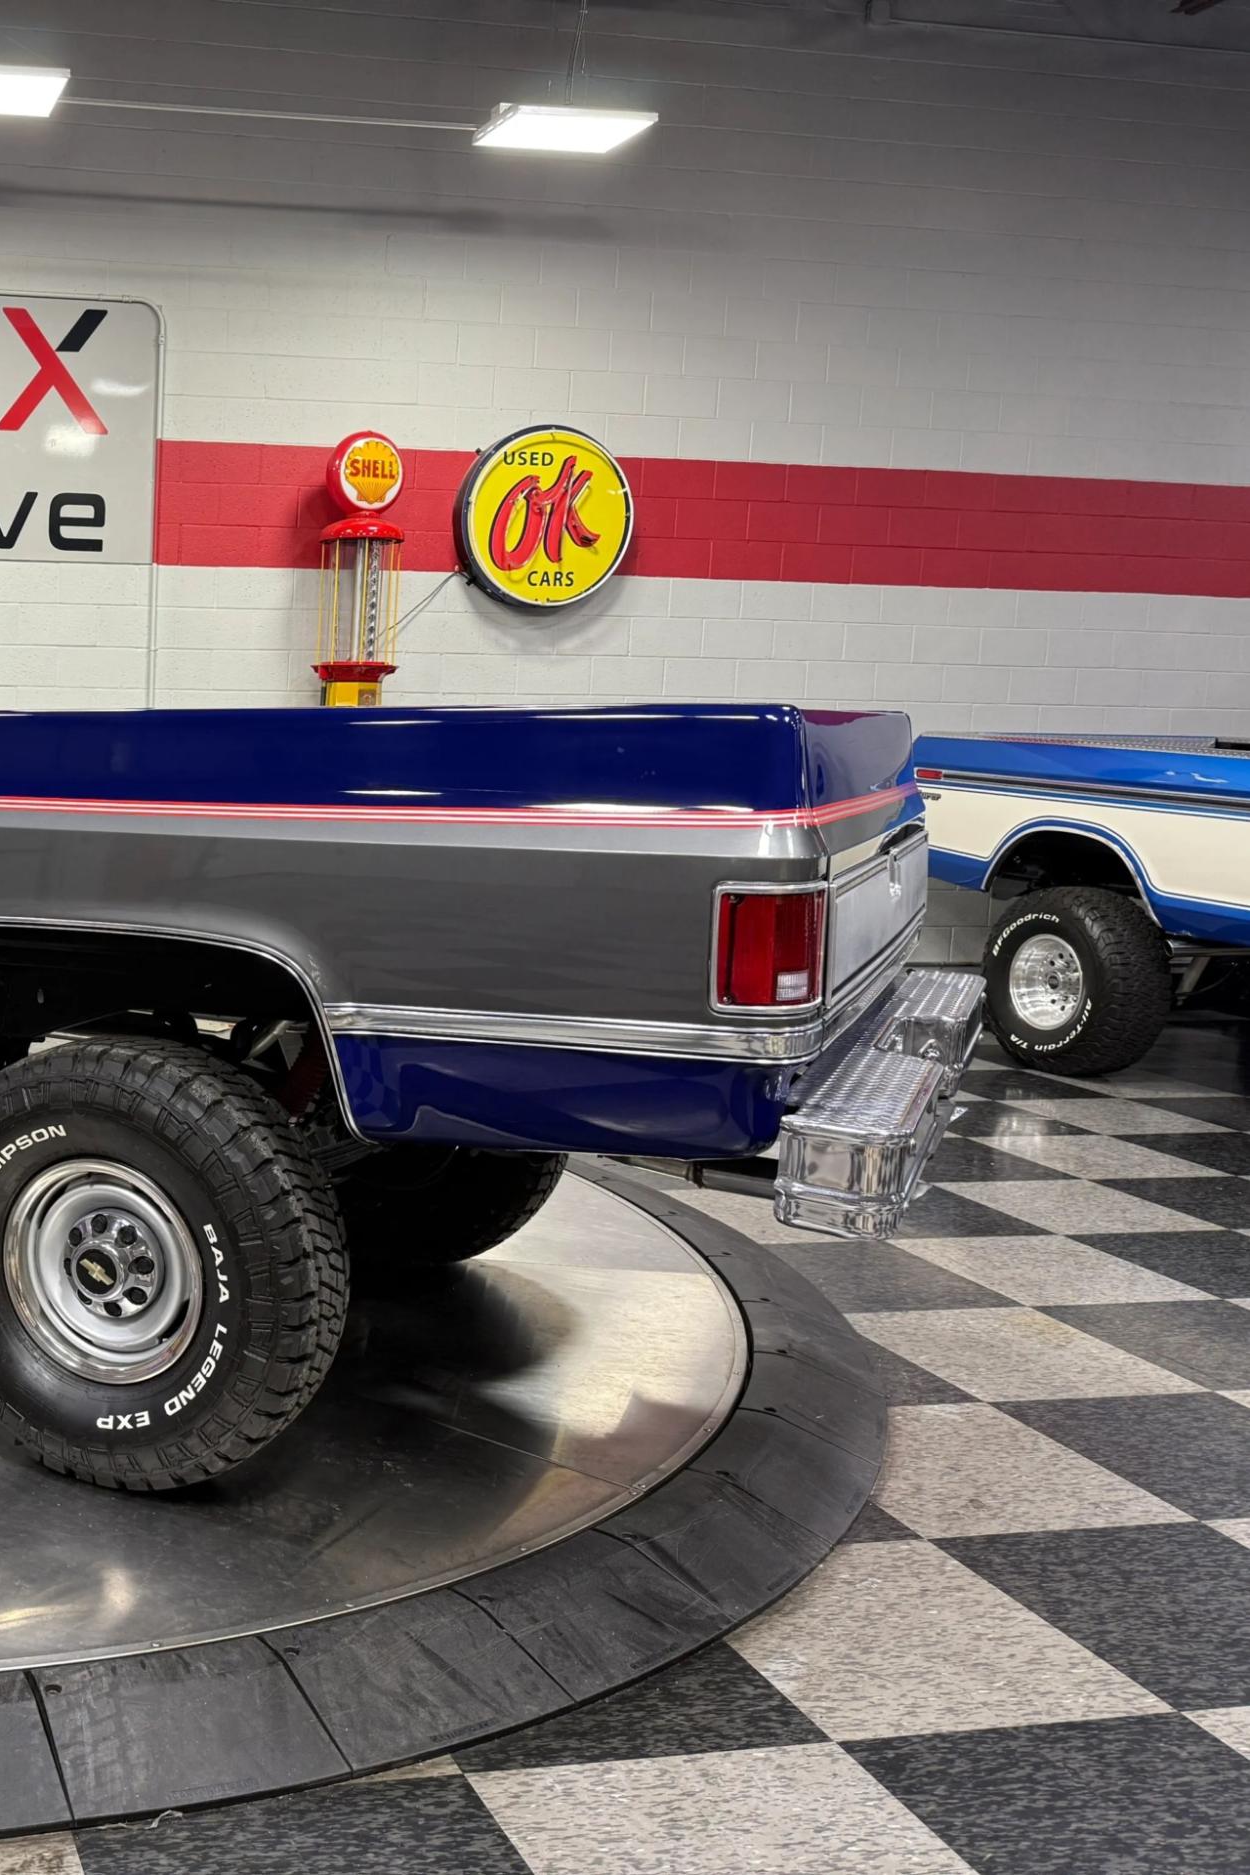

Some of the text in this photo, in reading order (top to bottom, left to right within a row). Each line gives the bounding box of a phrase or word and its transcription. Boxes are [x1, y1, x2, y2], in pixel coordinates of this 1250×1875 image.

[349, 457, 396, 480] SHELL
[503, 450, 554, 467] USED
[489, 455, 601, 572] OK
[527, 570, 575, 587] CARS
[992, 912, 1060, 956] BFGoodrich
[96, 1223, 231, 1431] BAJA LEGEND EXP
